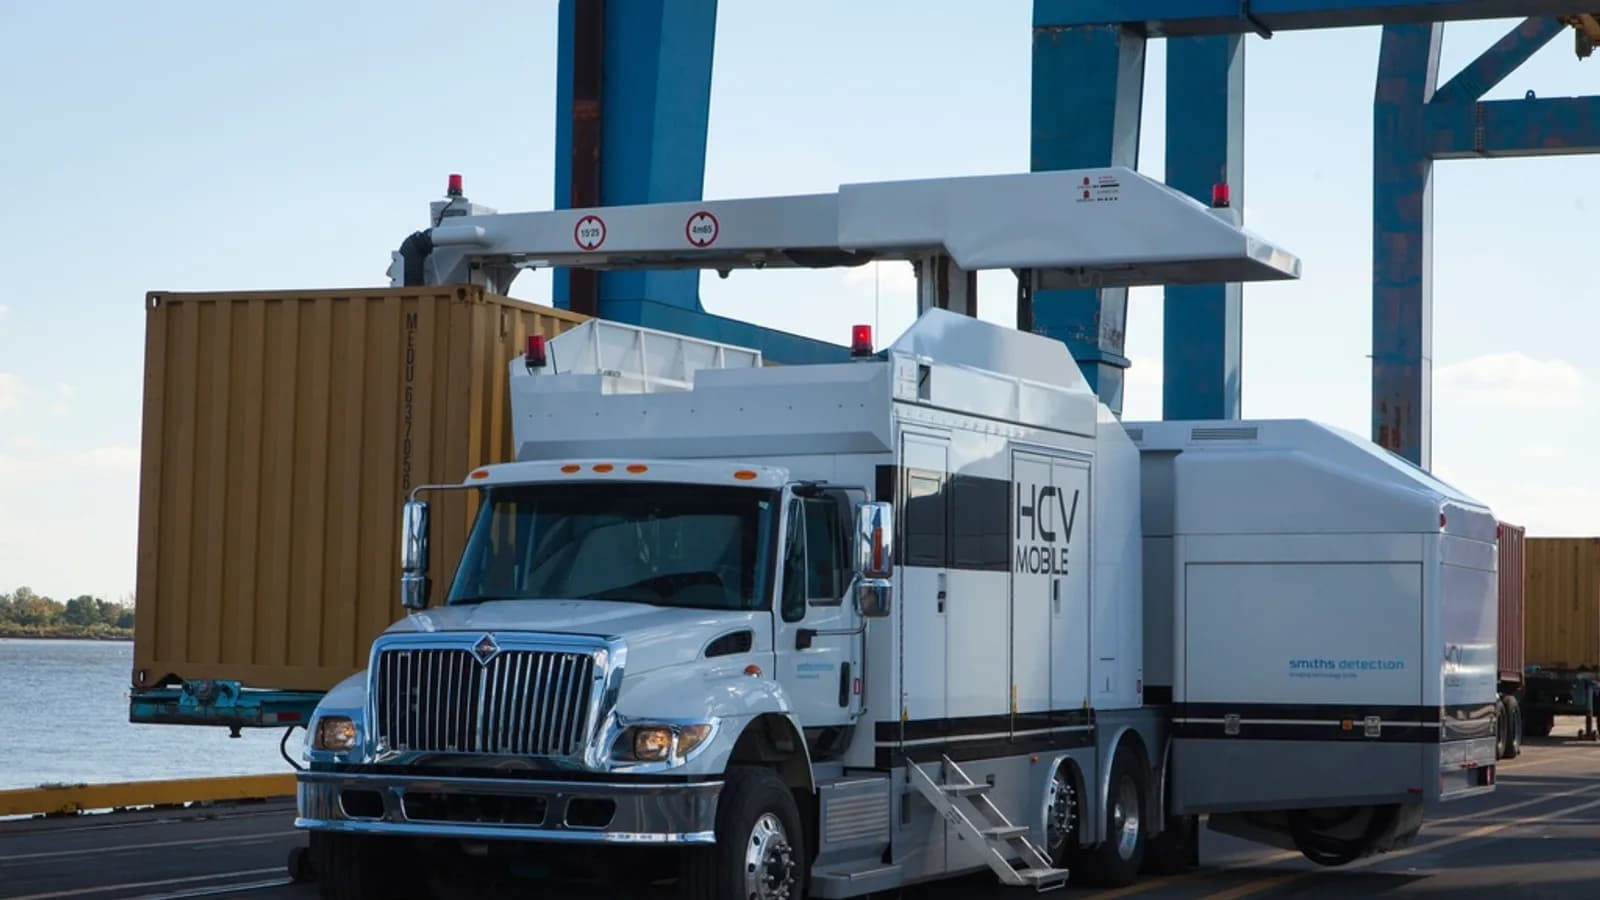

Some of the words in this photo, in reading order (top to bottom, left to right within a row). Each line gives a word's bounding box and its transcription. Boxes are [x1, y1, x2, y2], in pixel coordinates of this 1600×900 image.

[405, 312, 418, 383] MEDU
[1017, 482, 1080, 544] HCV
[1288, 659, 1336, 669] smiths
[1338, 659, 1405, 670] detection
